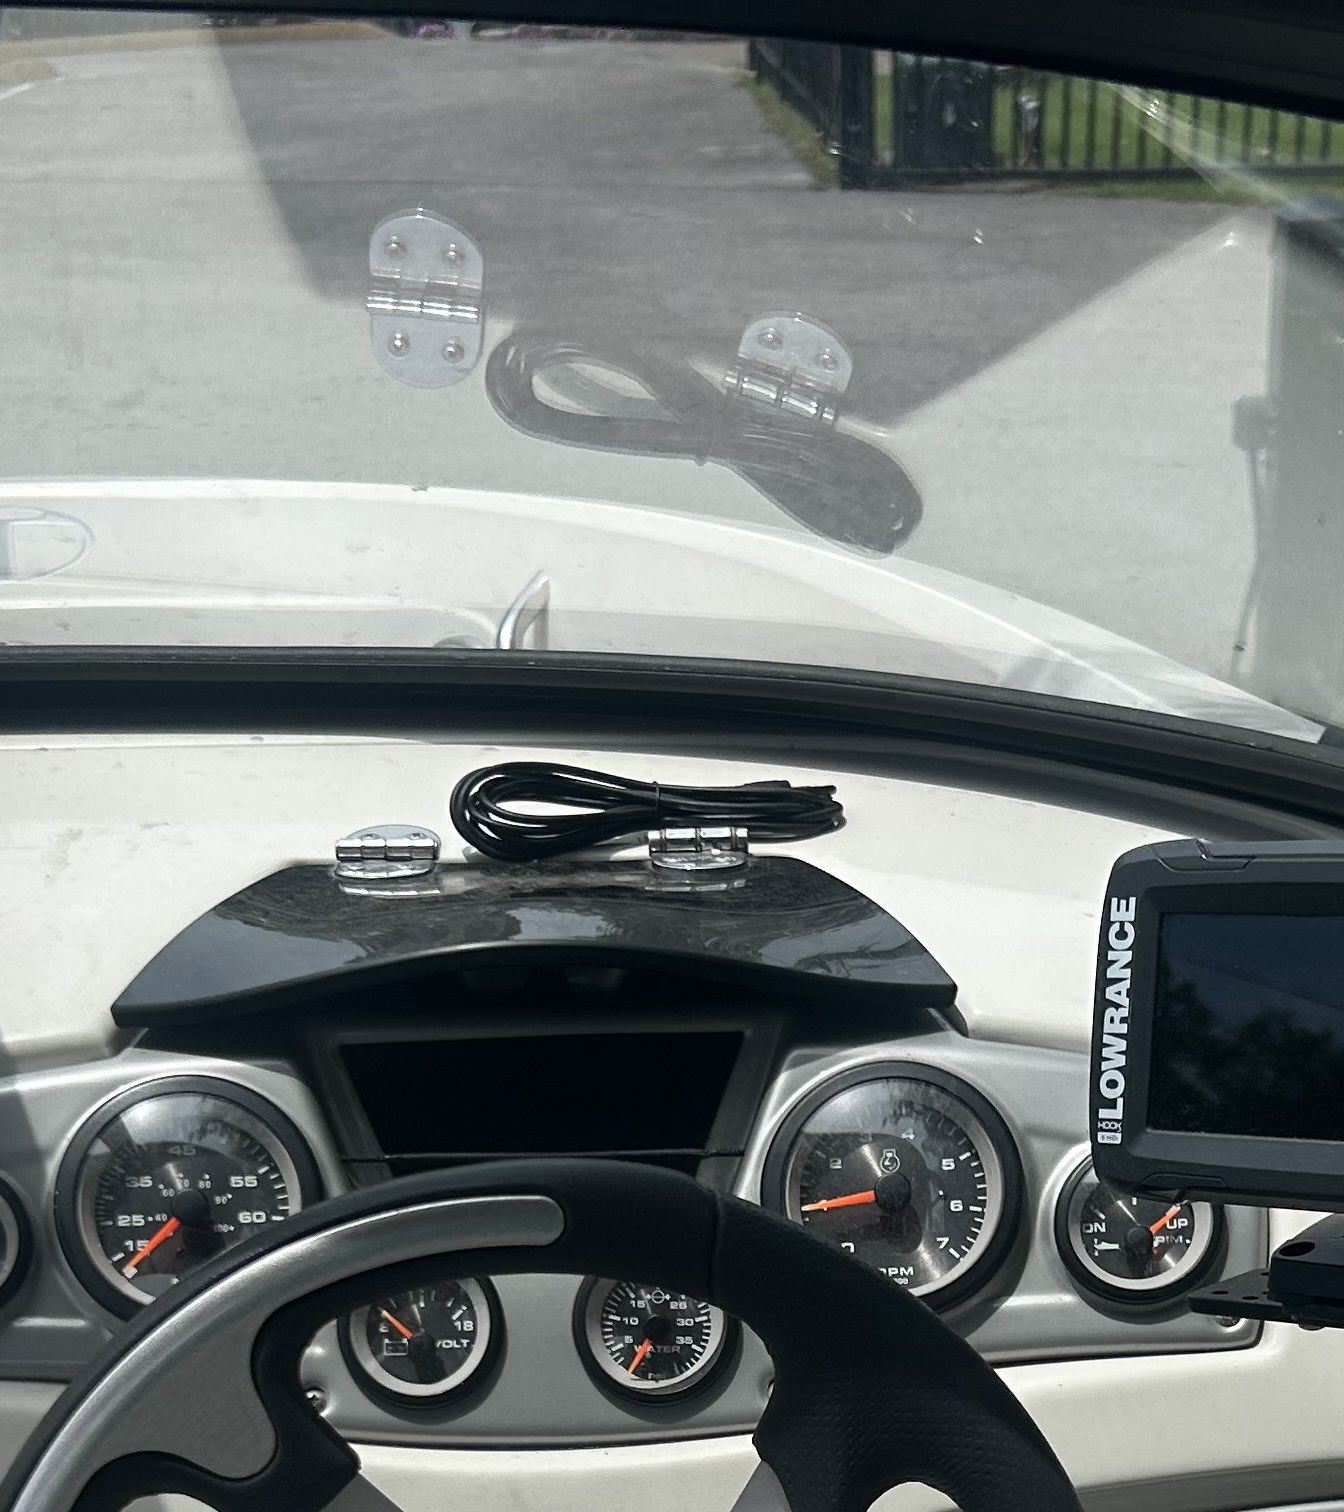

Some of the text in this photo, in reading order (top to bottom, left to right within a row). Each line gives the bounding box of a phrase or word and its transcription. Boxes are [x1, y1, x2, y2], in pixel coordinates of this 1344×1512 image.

[1098, 896, 1137, 1120] LOWRANCE
[941, 1158, 955, 1171] 5
[125, 1176, 153, 1187] 35
[230, 1176, 258, 1187] 55
[950, 1200, 963, 1212] 6
[117, 1215, 145, 1226] 25
[238, 1211, 267, 1224] 60
[1166, 1218, 1188, 1229] UP
[123, 1239, 150, 1251] 15
[936, 1237, 950, 1248] 7
[1155, 1235, 1183, 1244] RIM
[630, 1300, 646, 1309] 15
[454, 1320, 474, 1332] 18
[622, 1318, 639, 1326] 10
[676, 1318, 694, 1326] 30
[676, 1336, 693, 1345] 35
[634, 1345, 681, 1354] WATER
